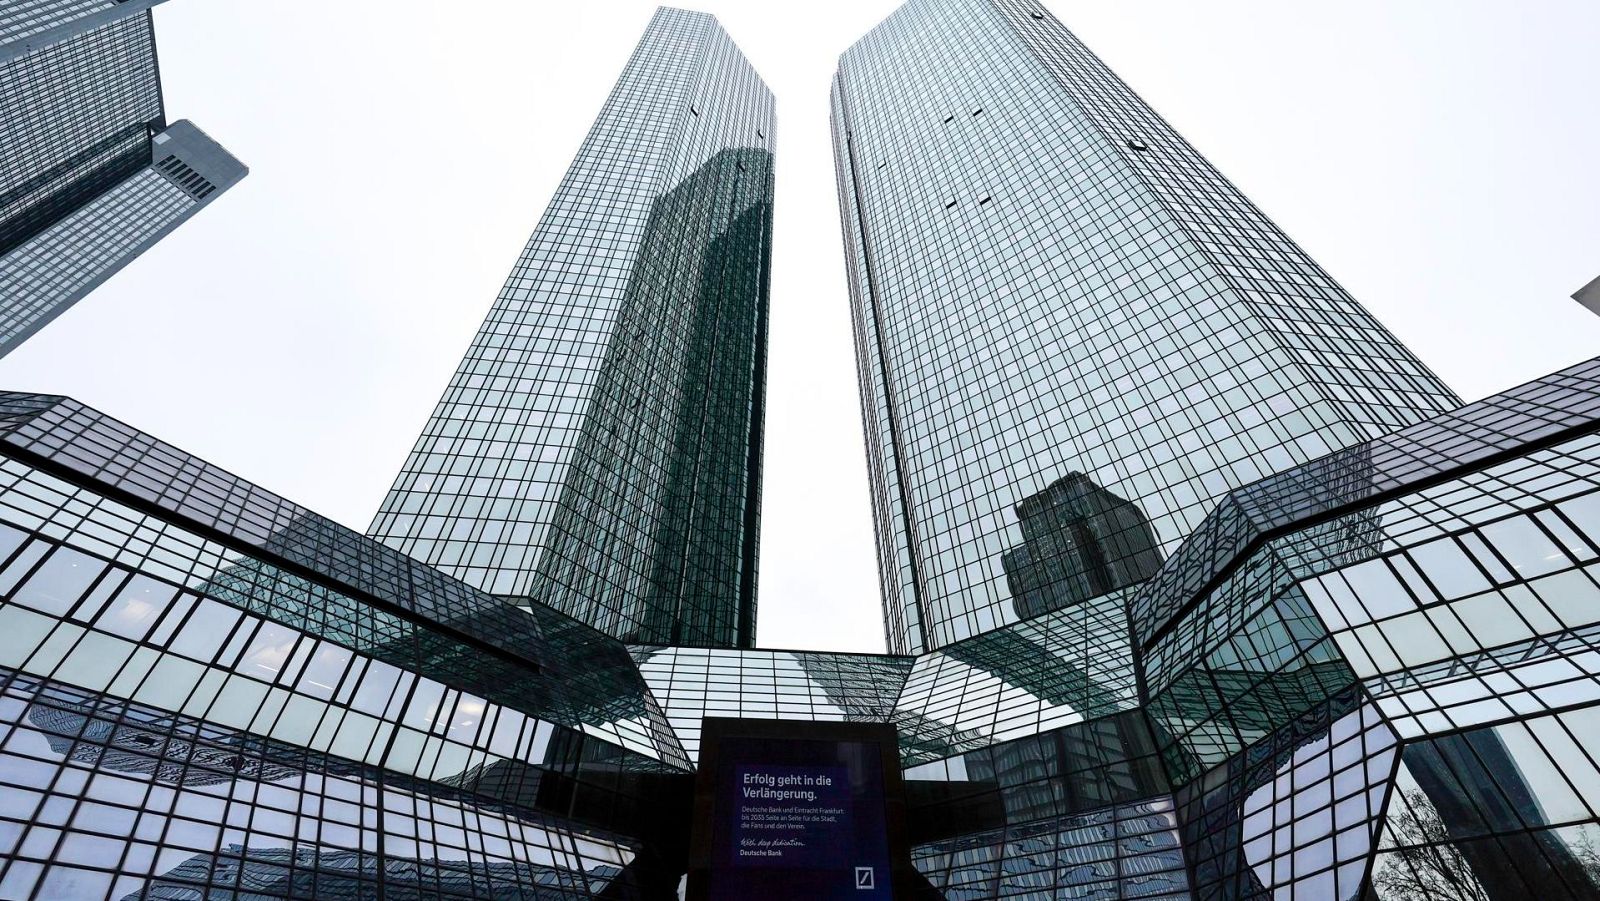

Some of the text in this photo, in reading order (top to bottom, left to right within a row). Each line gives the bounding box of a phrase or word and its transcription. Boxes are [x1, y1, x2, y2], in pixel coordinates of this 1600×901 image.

[744, 773, 832, 787] Erfolg geht in die
[743, 786, 818, 802] Verlängerung.
